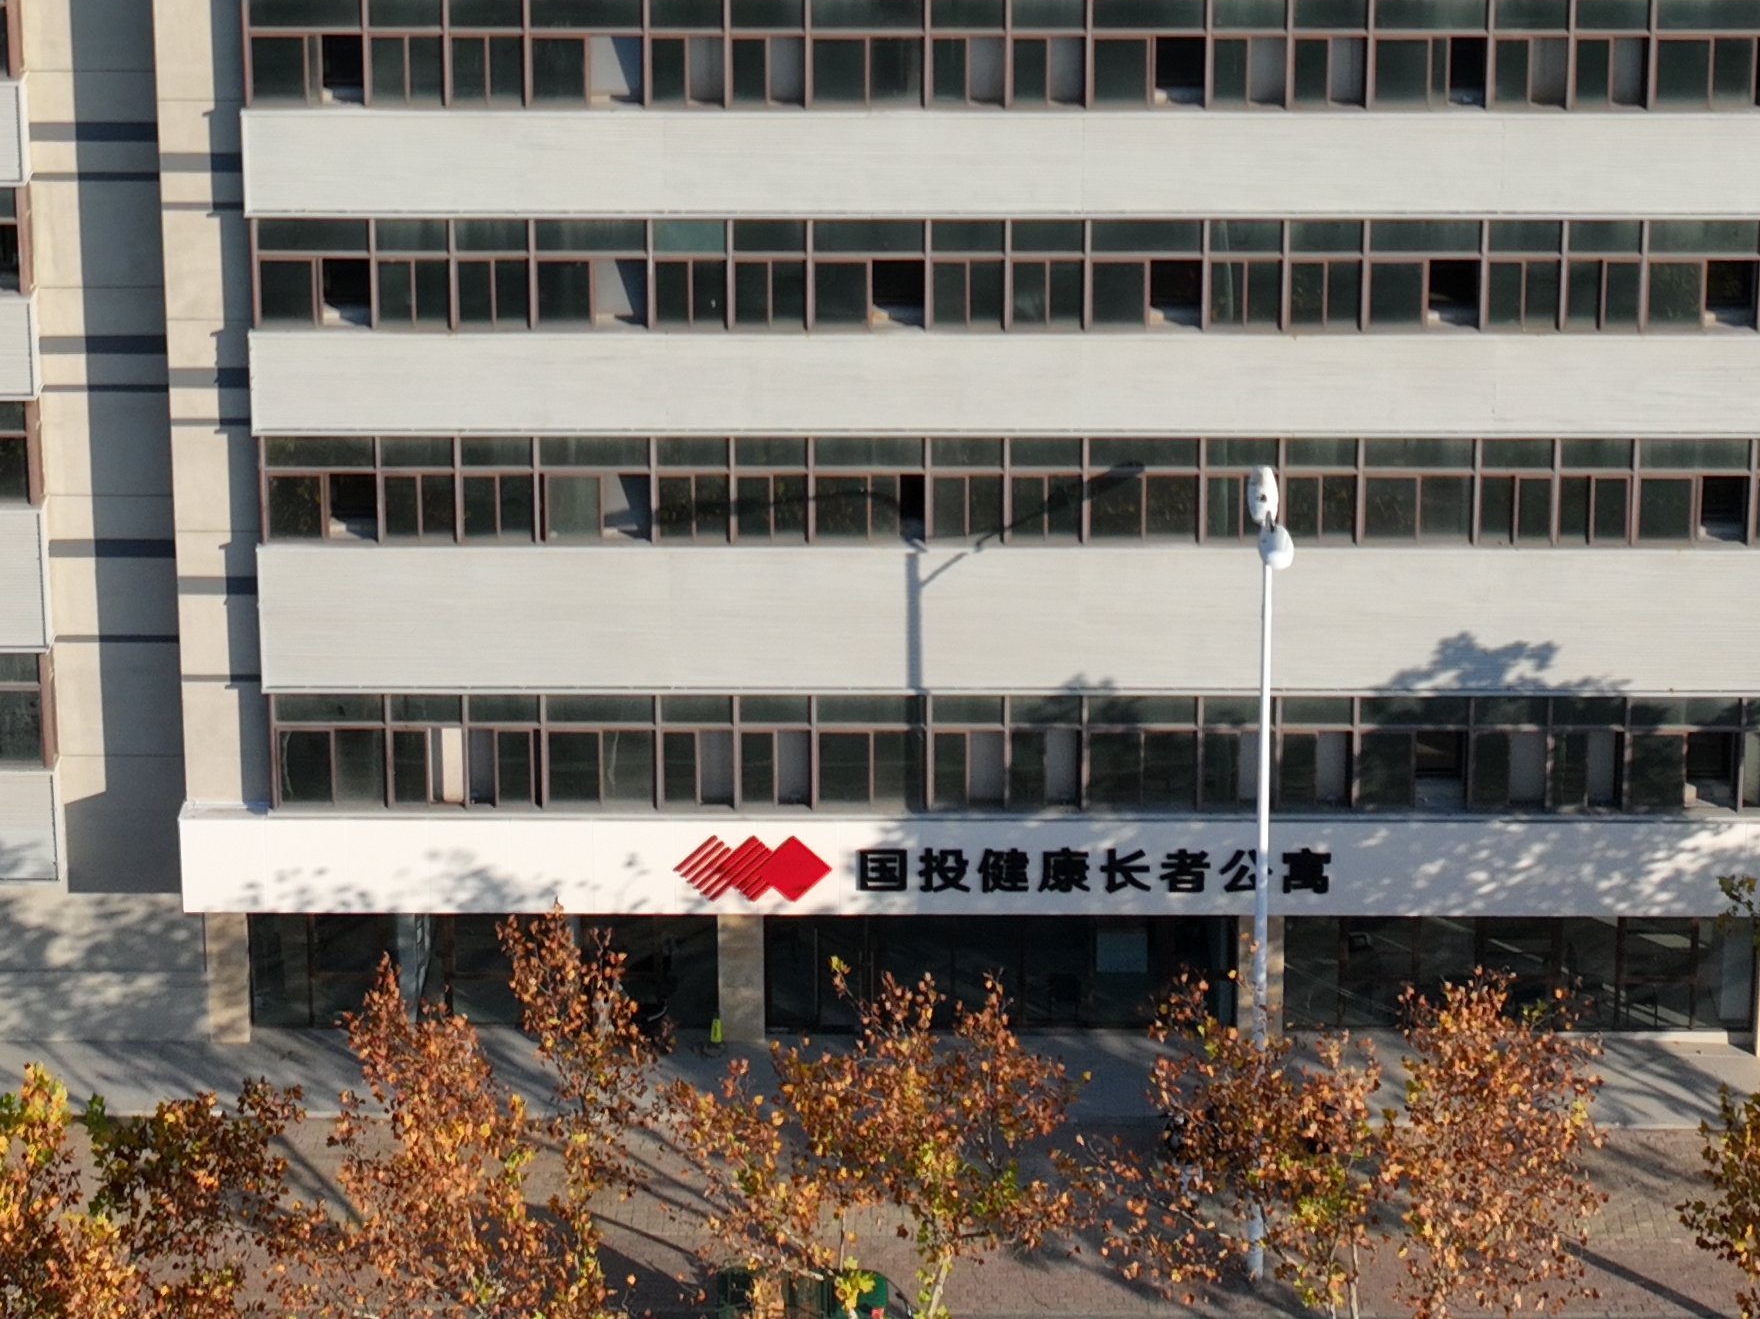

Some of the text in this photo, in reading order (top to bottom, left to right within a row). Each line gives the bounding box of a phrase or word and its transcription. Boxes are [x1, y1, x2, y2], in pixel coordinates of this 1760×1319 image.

[855, 847, 1332, 895] 国投健康长者公寓
